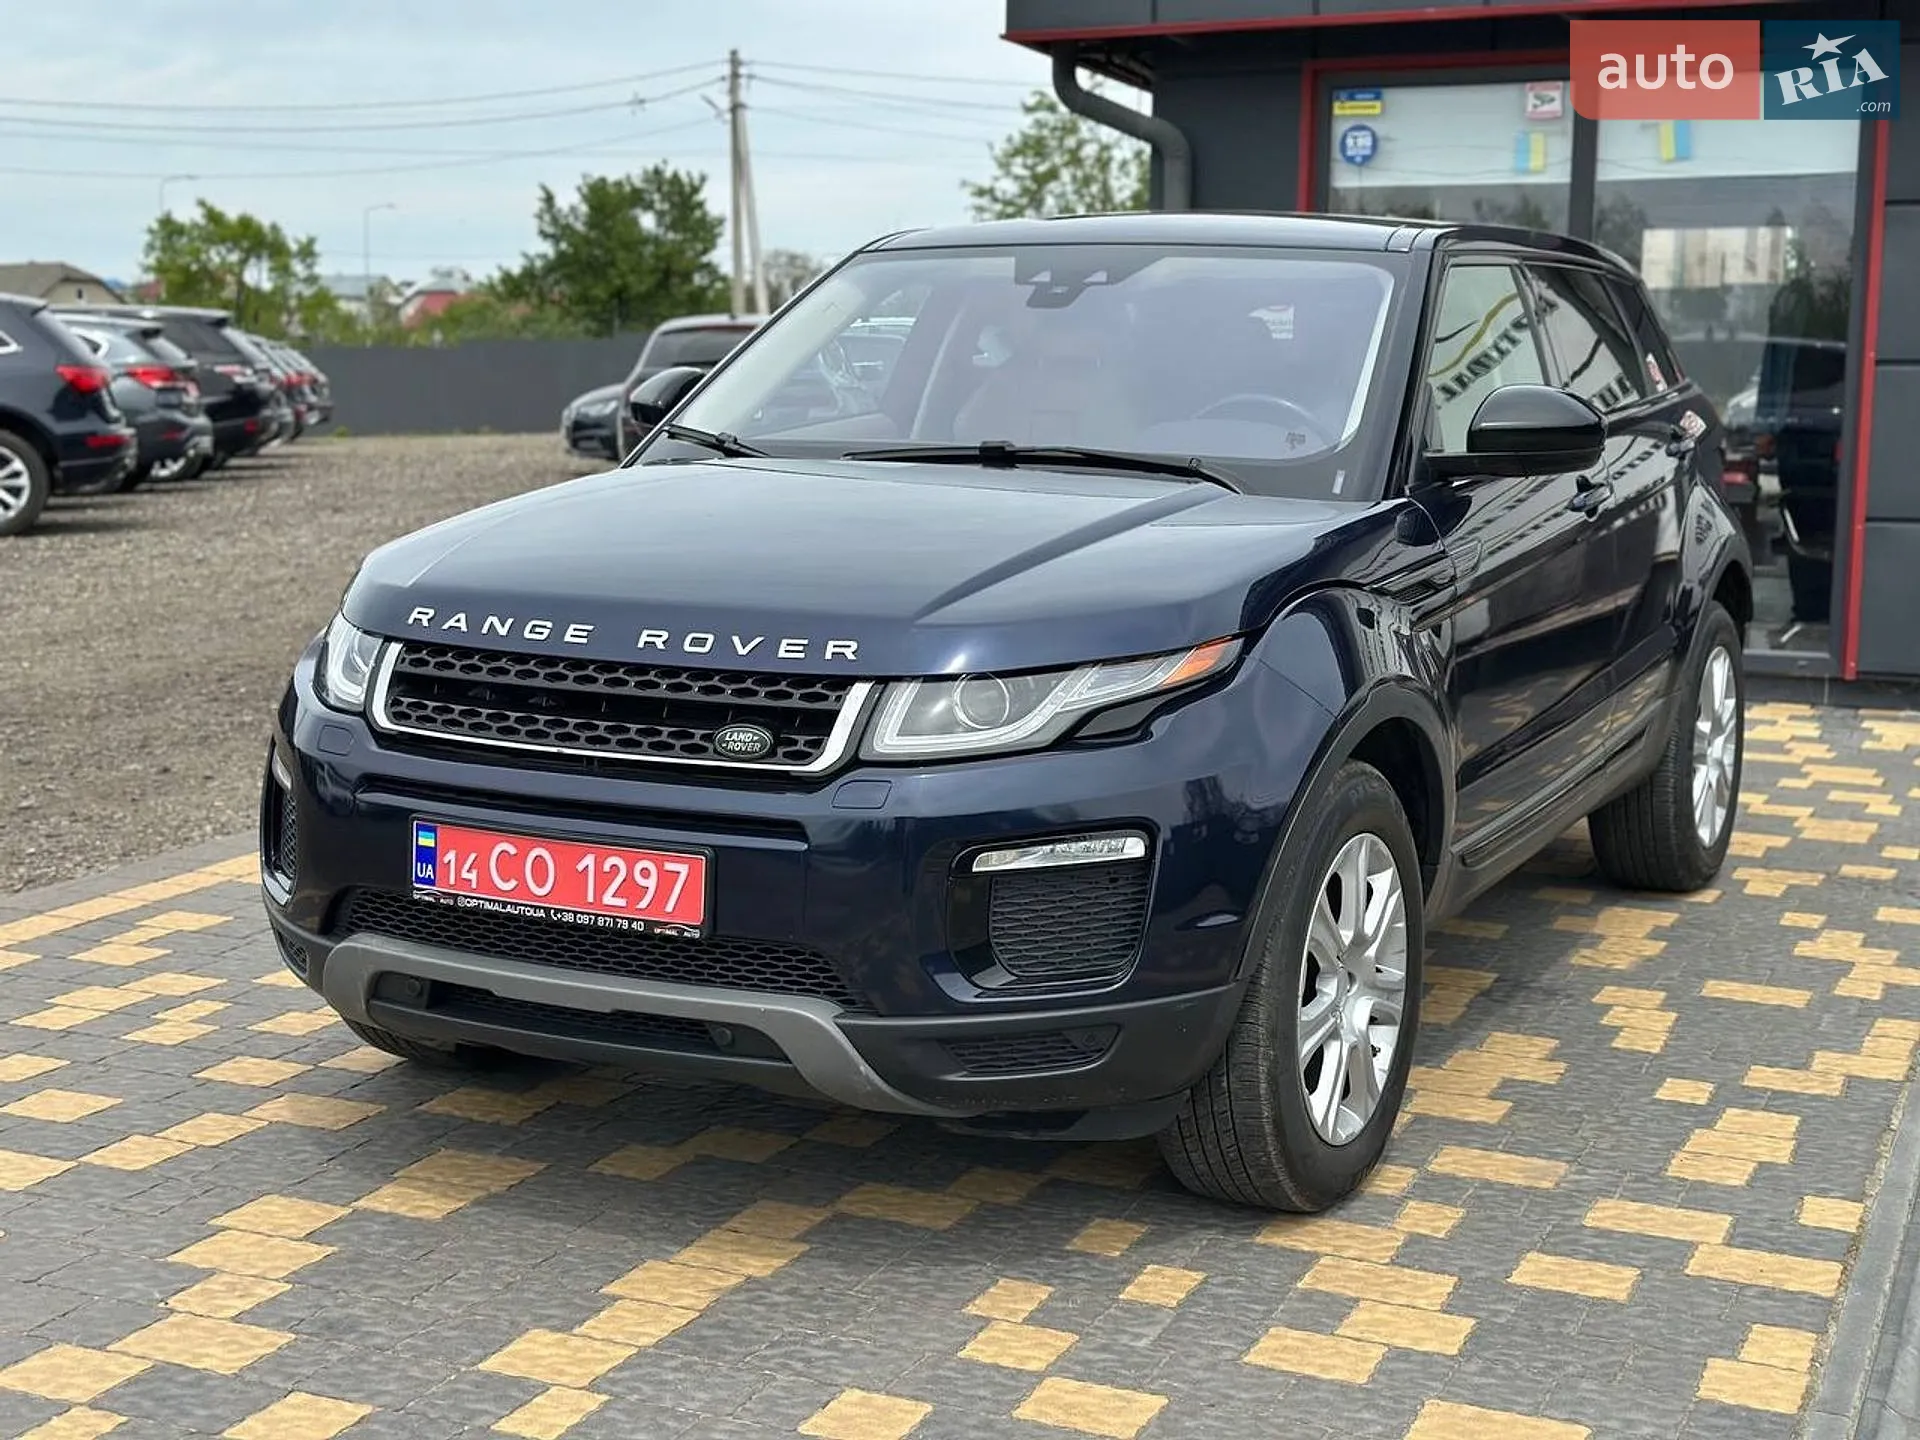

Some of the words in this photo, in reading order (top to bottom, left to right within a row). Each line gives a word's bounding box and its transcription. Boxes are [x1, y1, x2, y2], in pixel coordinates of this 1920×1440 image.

[407, 606, 596, 645] RANGE
[637, 629, 859, 661] ROVER
[725, 731, 752, 742] LAND
[727, 741, 761, 752] ROVER
[417, 862, 434, 880] UA
[443, 849, 478, 889] 14
[489, 842, 555, 896] CO
[576, 853, 690, 913] 1297
[631, 921, 645, 931] 40
